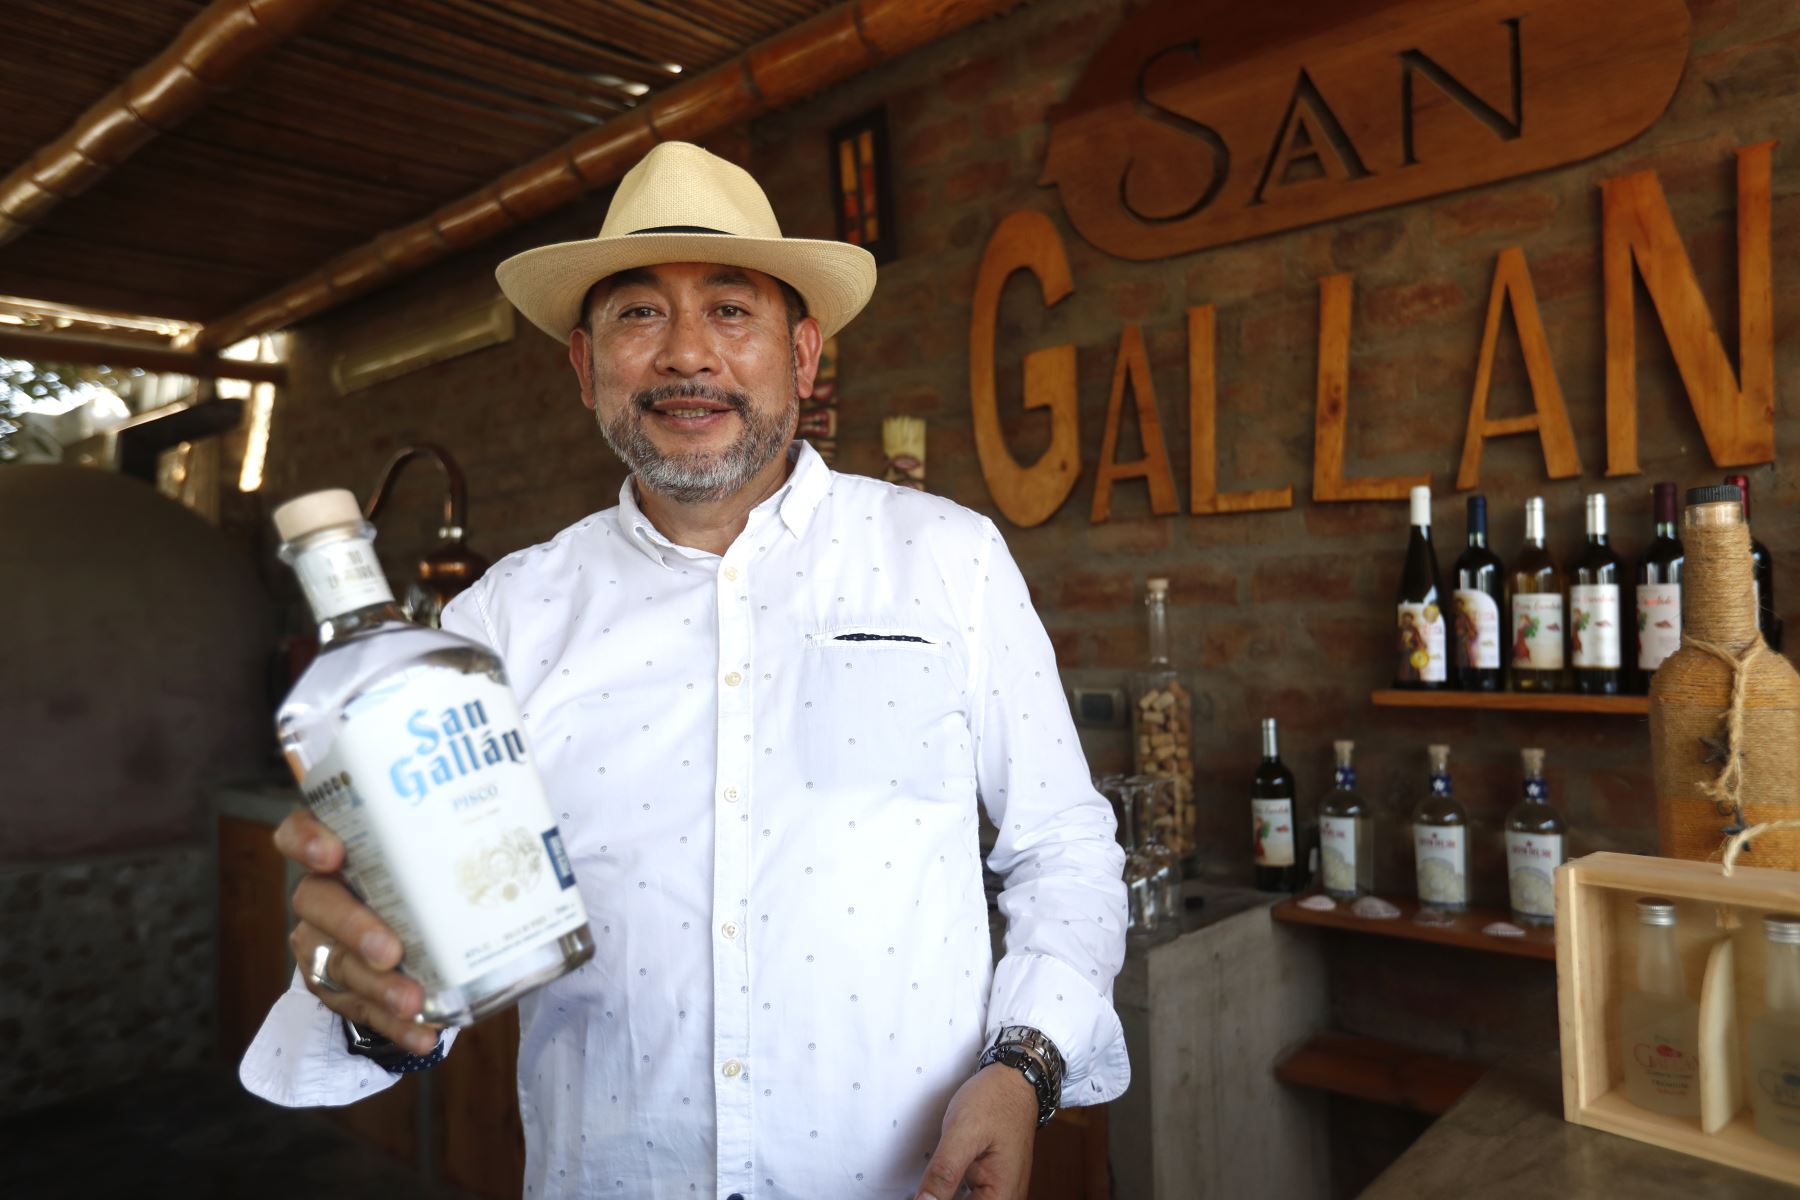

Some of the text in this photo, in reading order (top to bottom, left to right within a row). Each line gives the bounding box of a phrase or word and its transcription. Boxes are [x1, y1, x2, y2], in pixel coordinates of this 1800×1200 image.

[1118, 15, 1526, 226] SAN
[969, 140, 1778, 529] GALLAN
[388, 727, 526, 807] Gallán
[406, 698, 489, 757] San
[451, 783, 500, 812] PISCO
